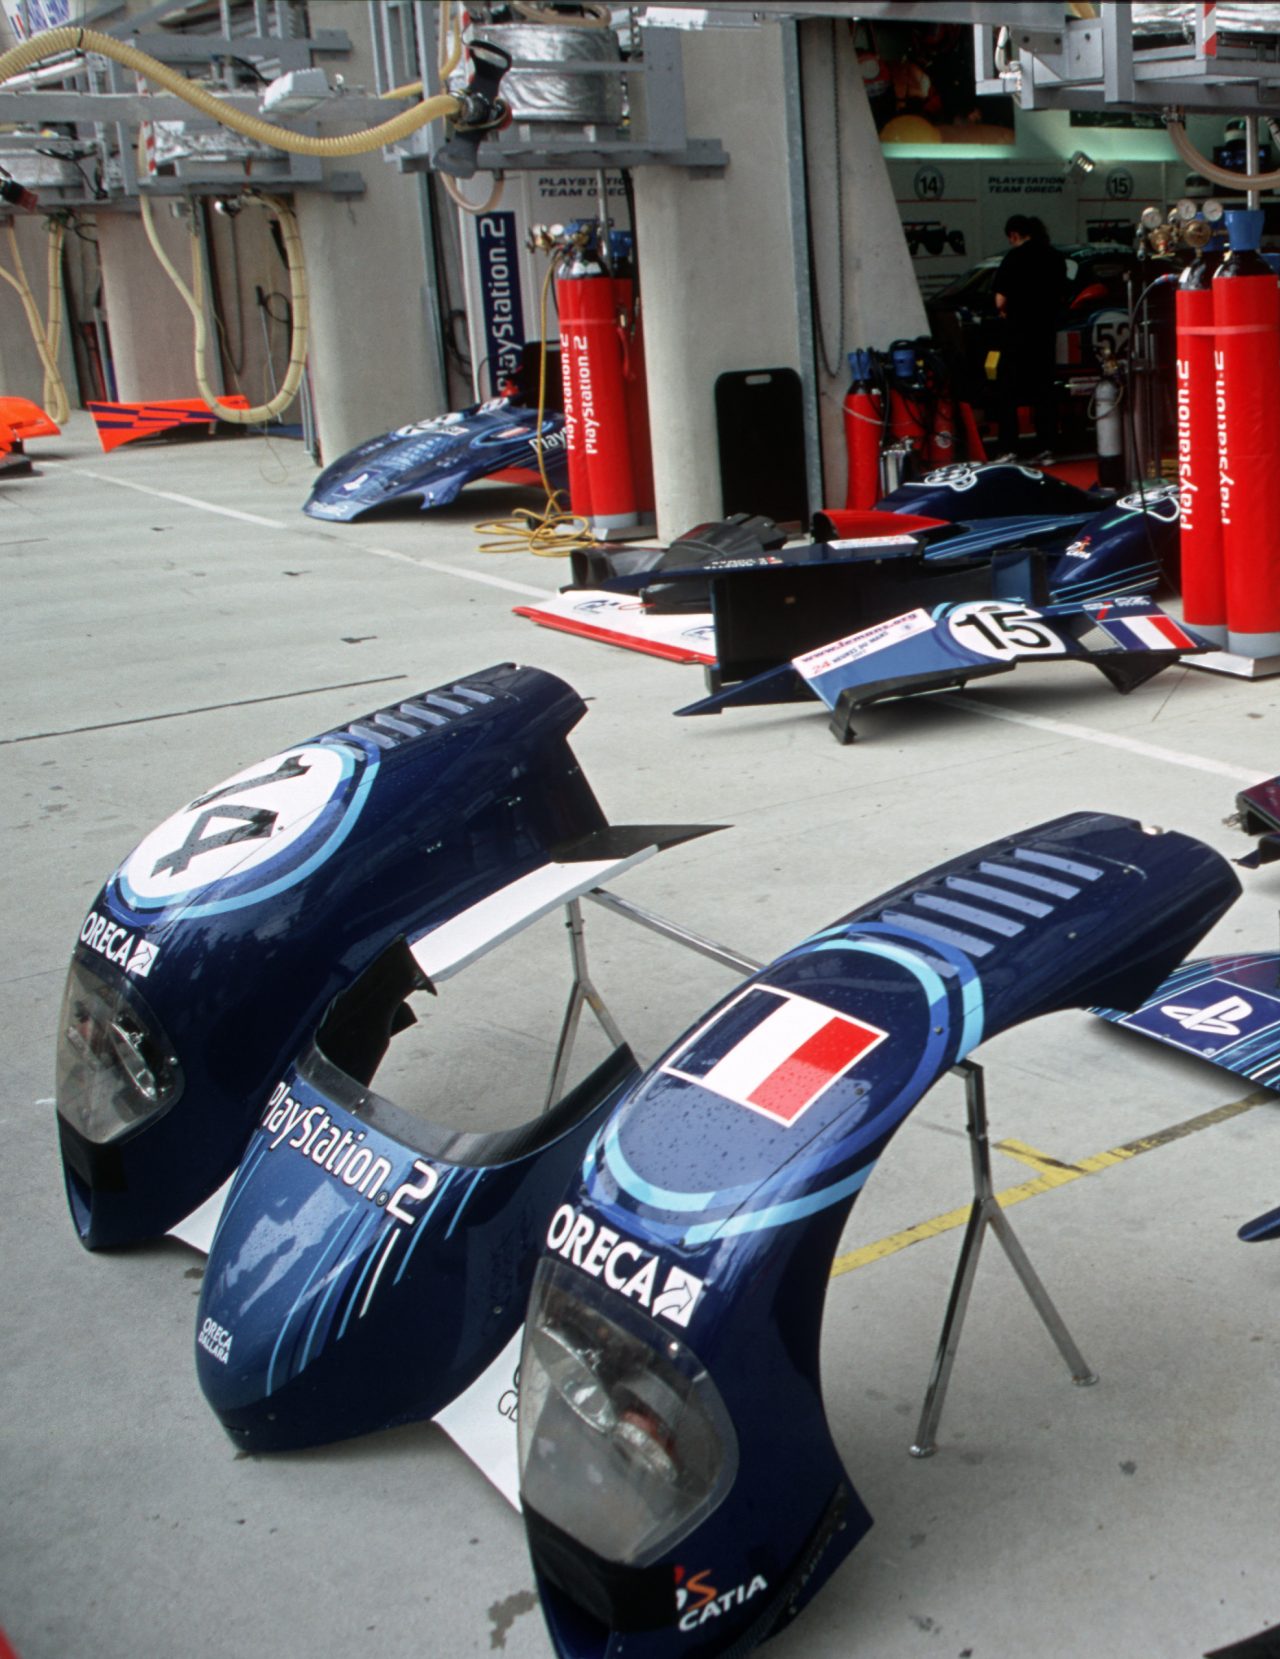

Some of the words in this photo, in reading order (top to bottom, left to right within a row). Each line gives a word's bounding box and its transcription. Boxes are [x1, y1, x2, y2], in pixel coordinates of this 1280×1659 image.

[540, 188, 583, 197] TEAM
[920, 177, 938, 194] 14
[988, 177, 1066, 185] PLAYSTATION
[988, 185, 1023, 194] TEAM
[1111, 178, 1128, 194] 15
[578, 359, 600, 455] PlayStation
[1178, 389, 1199, 530] PlayStation
[954, 610, 1052, 649] 15
[812, 659, 831, 674] 24
[150, 753, 312, 880] 14
[79, 911, 136, 967] ORECA
[262, 1081, 393, 1200] PlayStation
[386, 1159, 439, 1225] 2
[546, 1203, 660, 1308] ORECA
[198, 1330, 229, 1364] DALLARA
[203, 1317, 233, 1351] ORECA
[678, 1573, 768, 1632] CATIA
